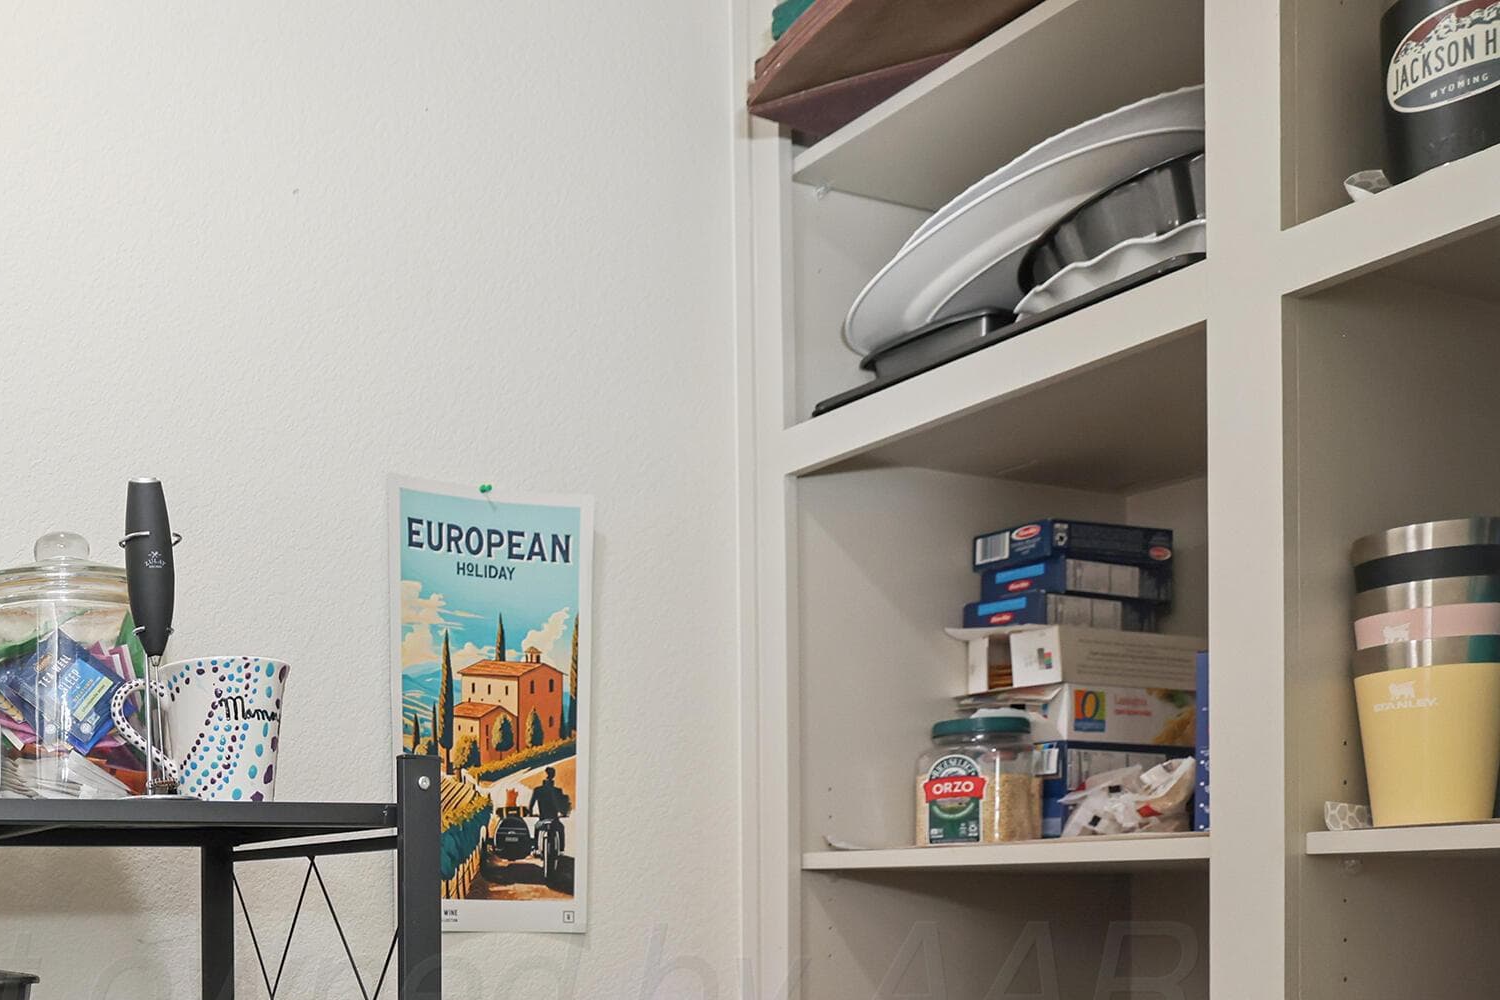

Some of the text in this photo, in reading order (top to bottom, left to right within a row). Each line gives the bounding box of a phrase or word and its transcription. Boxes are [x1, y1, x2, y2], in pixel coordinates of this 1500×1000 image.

[1393, 34, 1475, 96] JACKSON
[1430, 73, 1489, 99] WYOMING
[407, 516, 572, 563] EUROPEAN
[457, 561, 515, 580] HOLIDAY
[932, 781, 975, 795] ORZO
